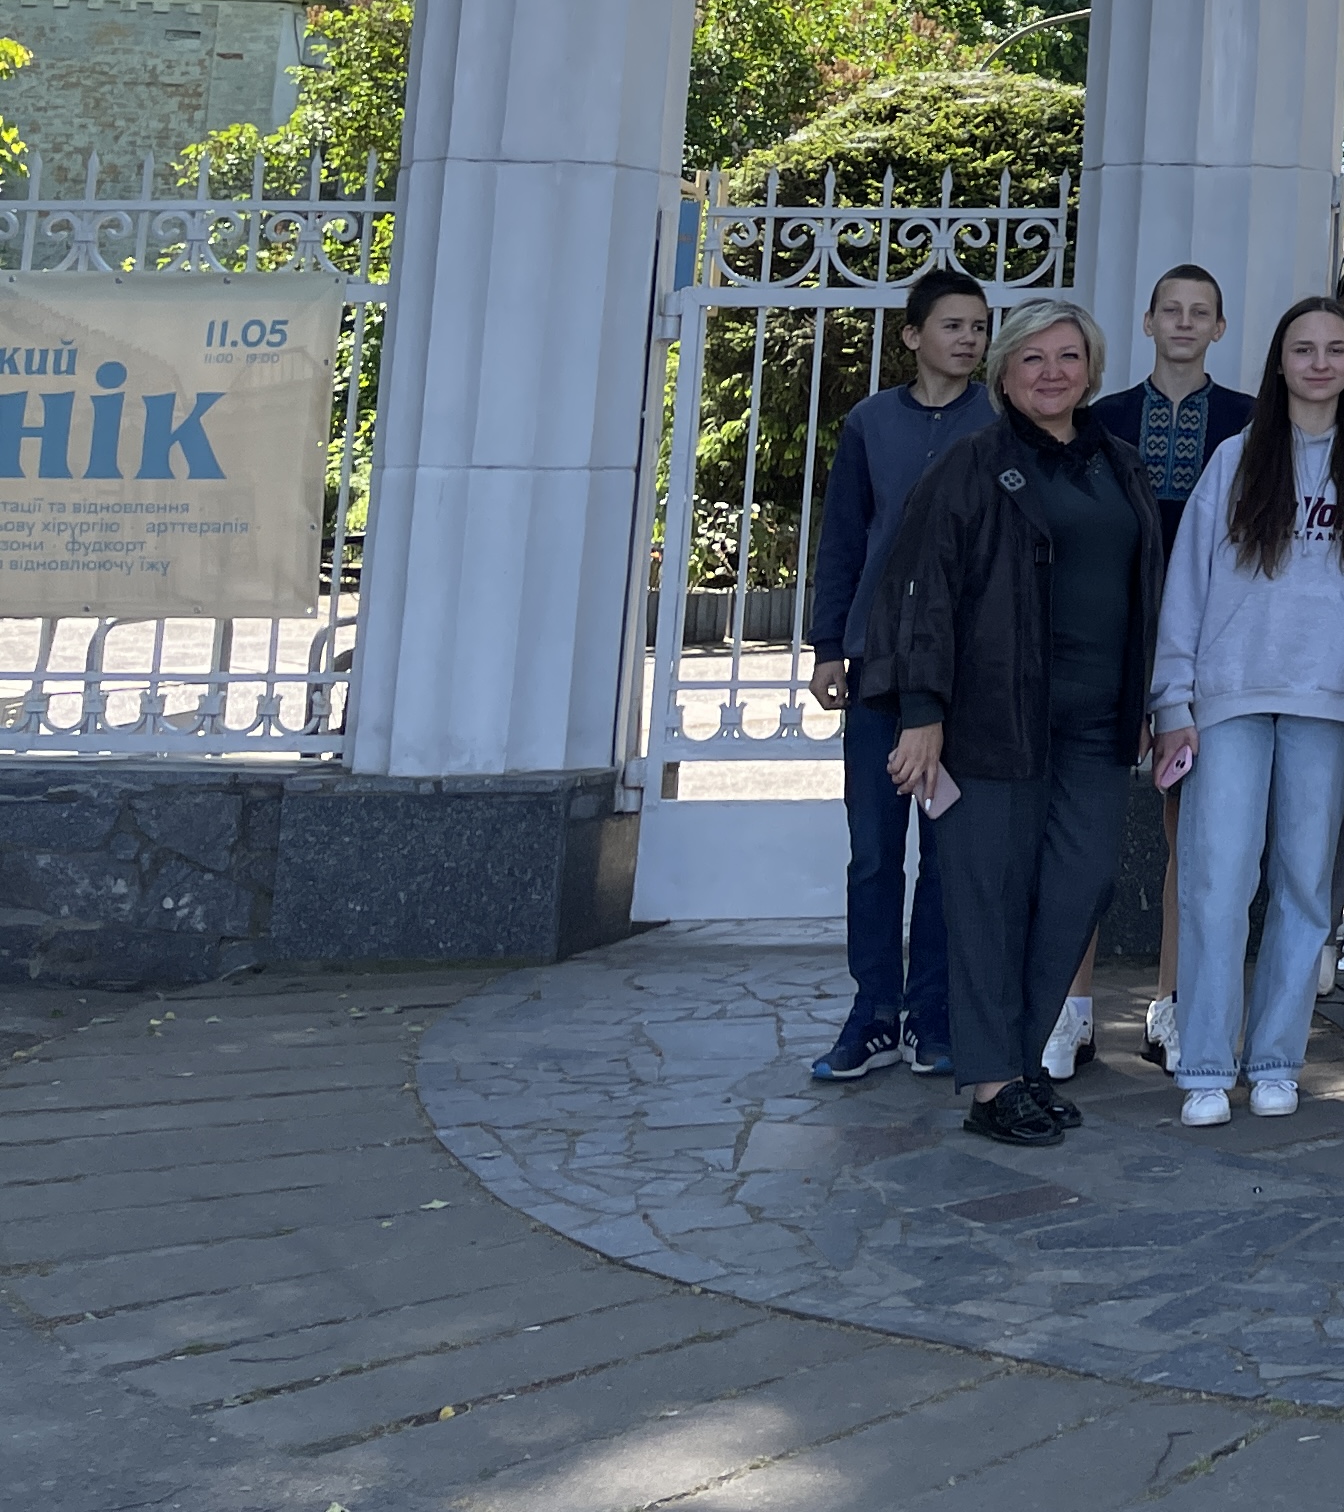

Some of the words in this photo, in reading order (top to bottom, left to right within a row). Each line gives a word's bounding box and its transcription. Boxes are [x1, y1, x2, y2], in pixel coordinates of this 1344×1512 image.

[206, 319, 289, 348] 11.05
[47, 501, 67, 514] та
[72, 498, 190, 516] відновлення
[41, 517, 121, 539] хірургію
[146, 518, 249, 537] арттерапія
[65, 537, 147, 557] фудкорт
[9, 555, 135, 575] відновлюючу
[139, 556, 171, 576] їжу
